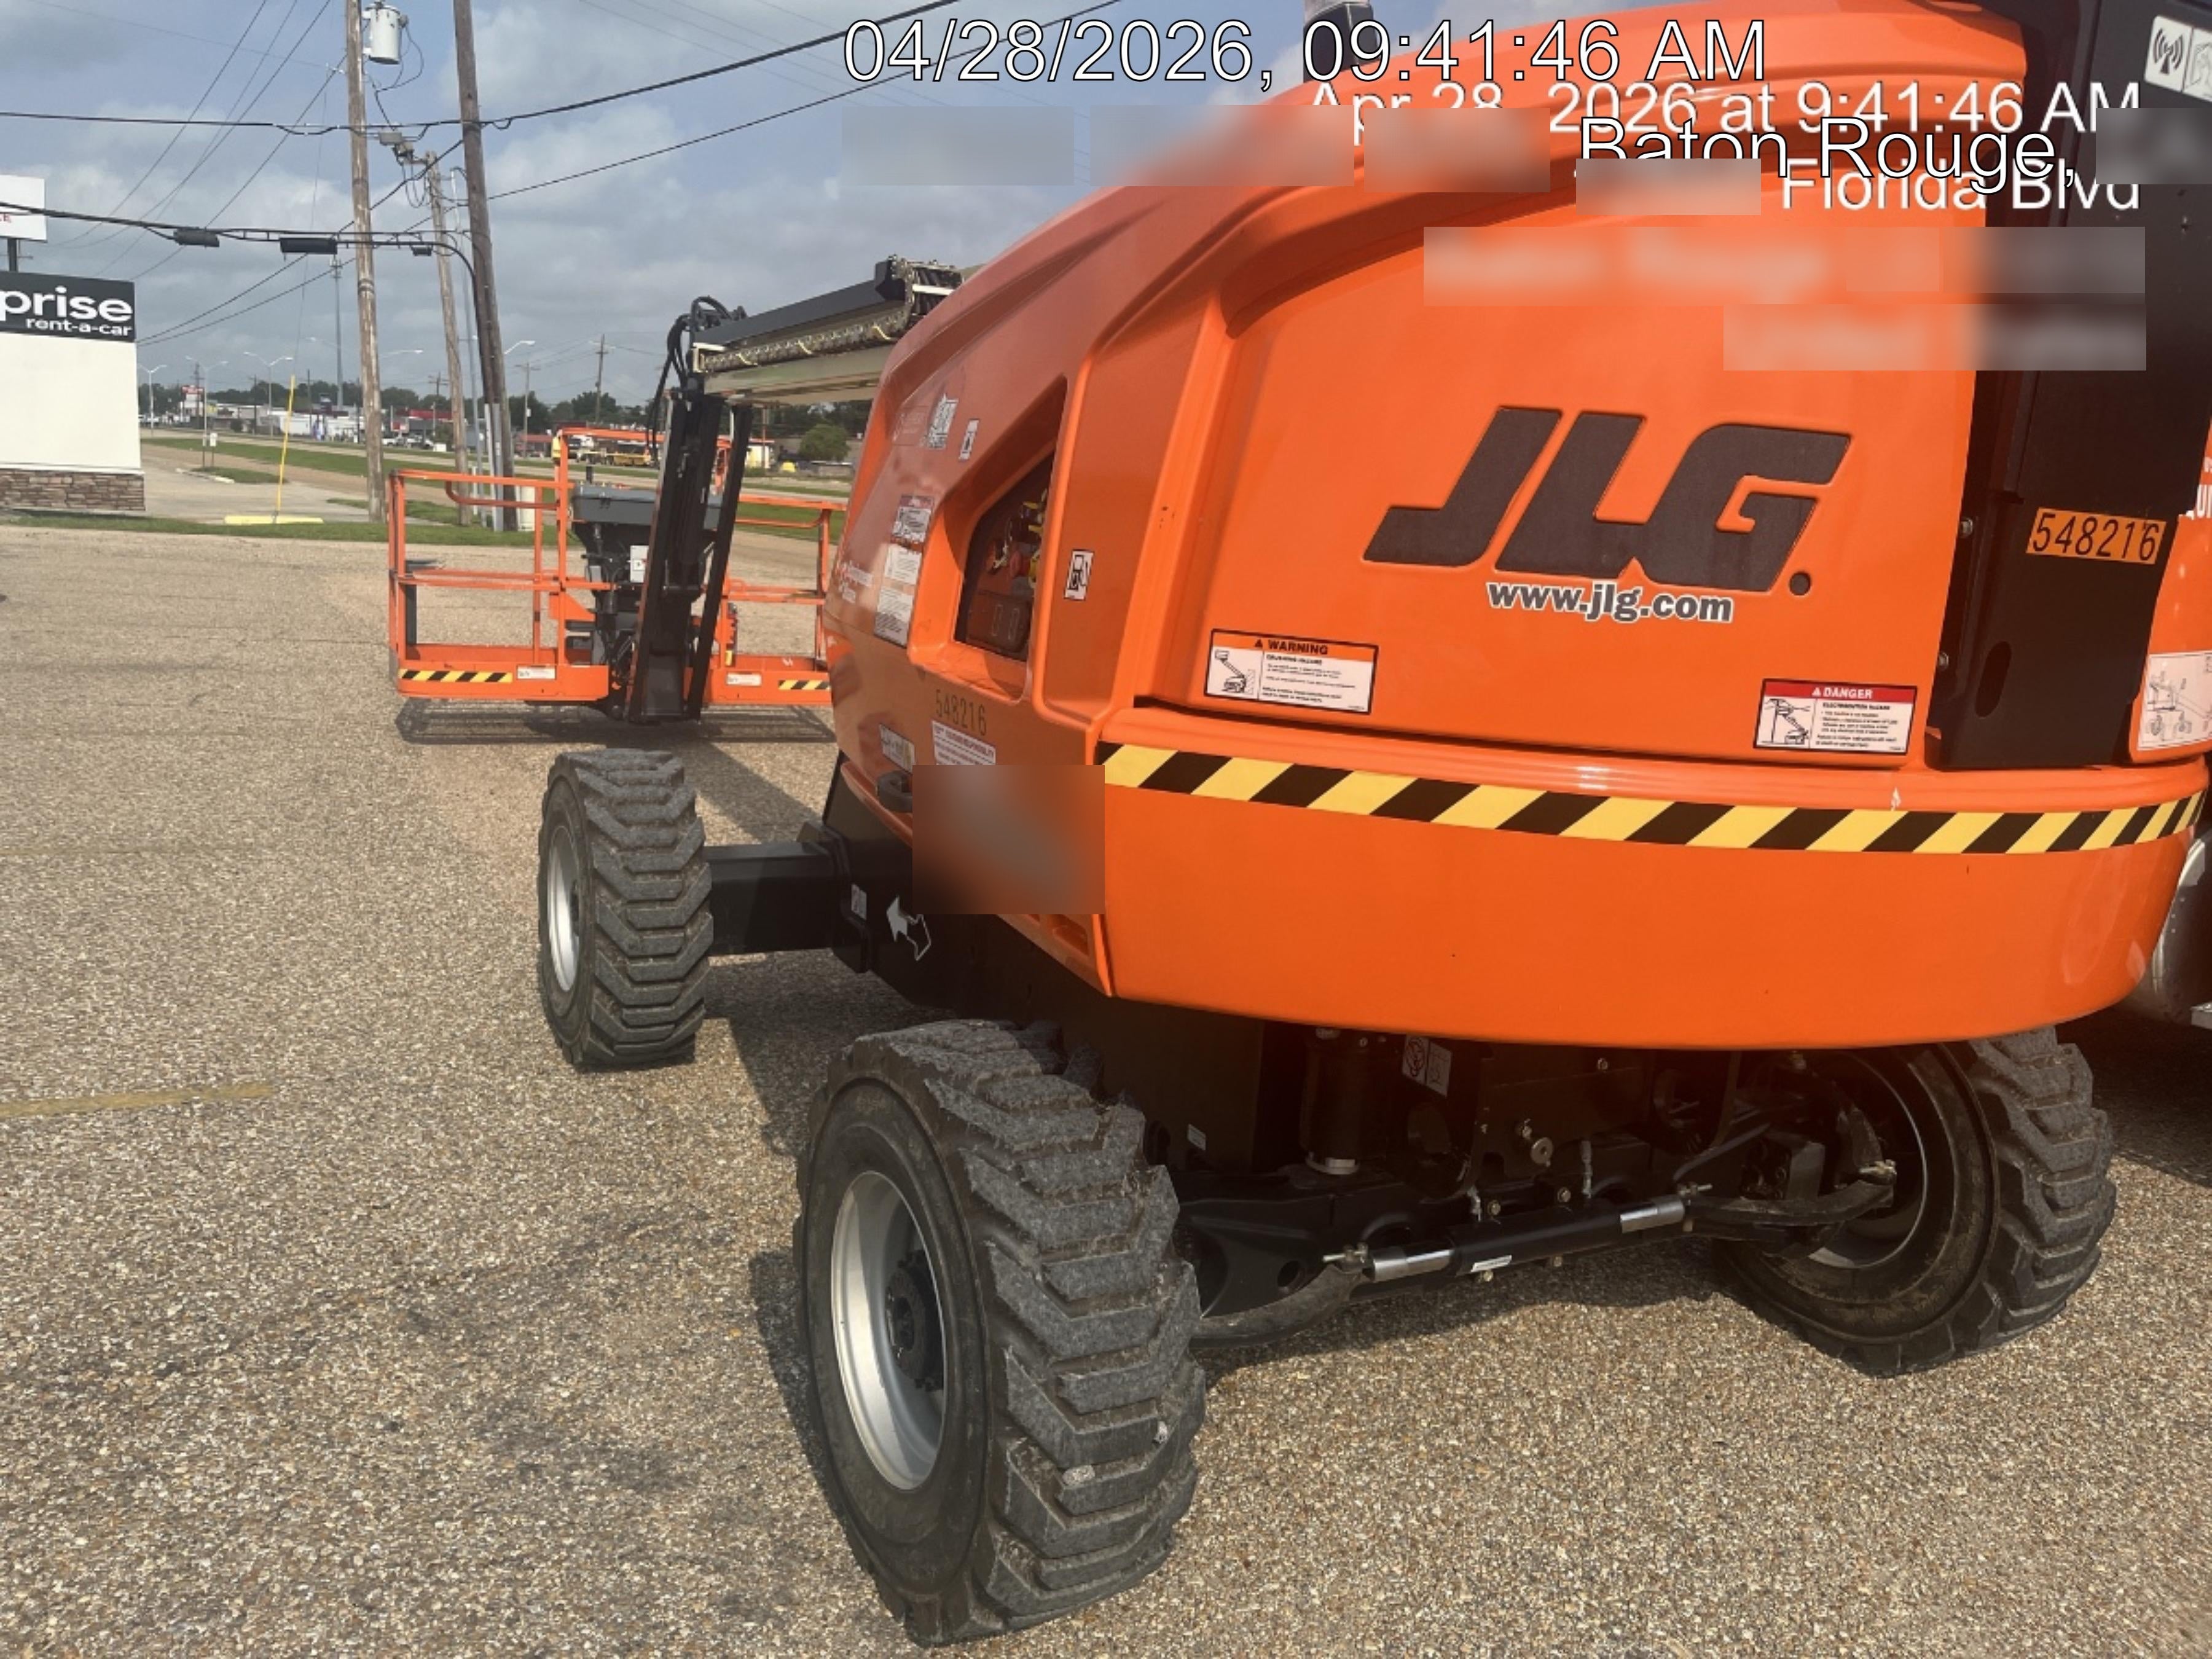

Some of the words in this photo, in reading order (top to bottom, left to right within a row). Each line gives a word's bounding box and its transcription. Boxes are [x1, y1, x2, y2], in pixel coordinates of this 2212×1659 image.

[0, 286, 133, 322] prise
[26, 318, 132, 336] rent-a-car
[1362, 406, 1852, 594] JLG
[2033, 514, 2161, 562] 548216
[1486, 580, 1734, 623] www.jlg.com
[1268, 640, 1328, 655] WARNING
[935, 689, 987, 736] 548216
[1822, 687, 1873, 699] DANGER
